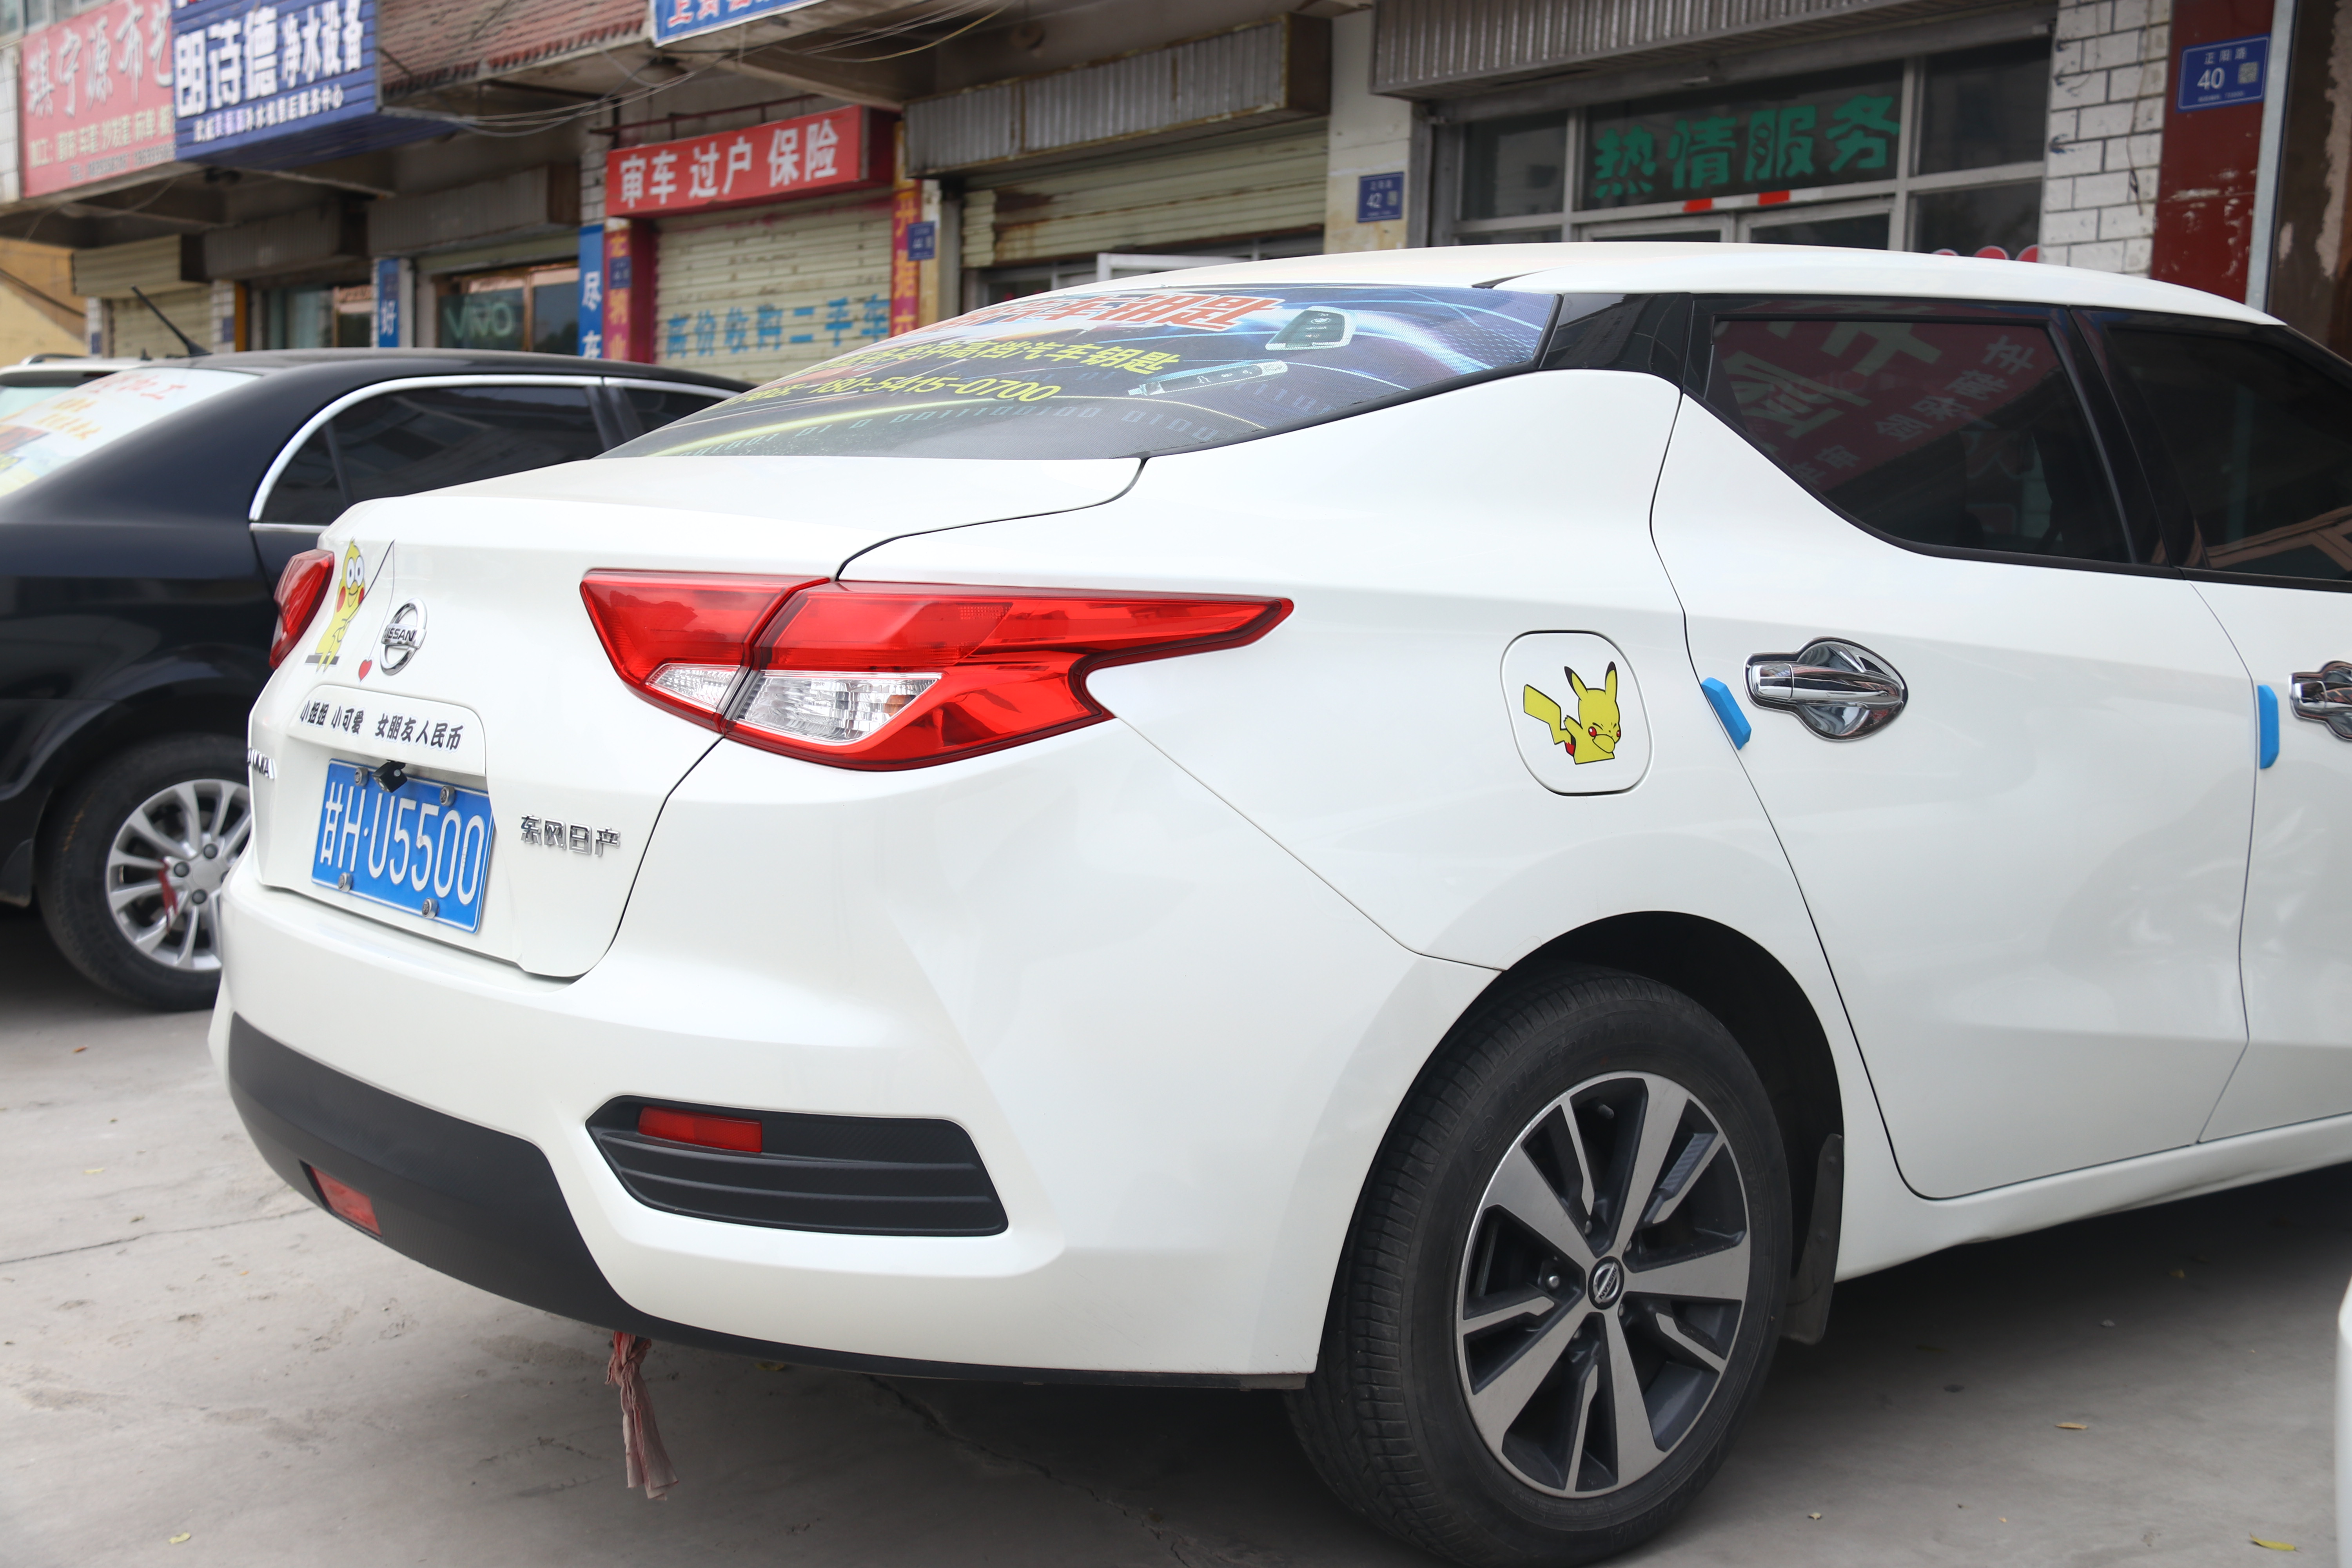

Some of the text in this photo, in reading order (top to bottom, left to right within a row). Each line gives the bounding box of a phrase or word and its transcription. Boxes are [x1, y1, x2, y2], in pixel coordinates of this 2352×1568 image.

[281, 0, 364, 89] 净水设备
[2196, 67, 2225, 91] 40
[620, 118, 839, 209] 审车 过户 保险
[1595, 94, 1900, 199] 热情服务
[1366, 192, 1383, 209] 42
[666, 294, 892, 359] 高价收购二手车
[808, 375, 1062, 403] 180-5415-0700
[383, 627, 418, 642] NISSAN
[299, 699, 464, 751] 小姐姐 小可爱 女朋友人民币
[520, 814, 621, 857] 东风日产
[1599, 1267, 1617, 1299] NISSAN
